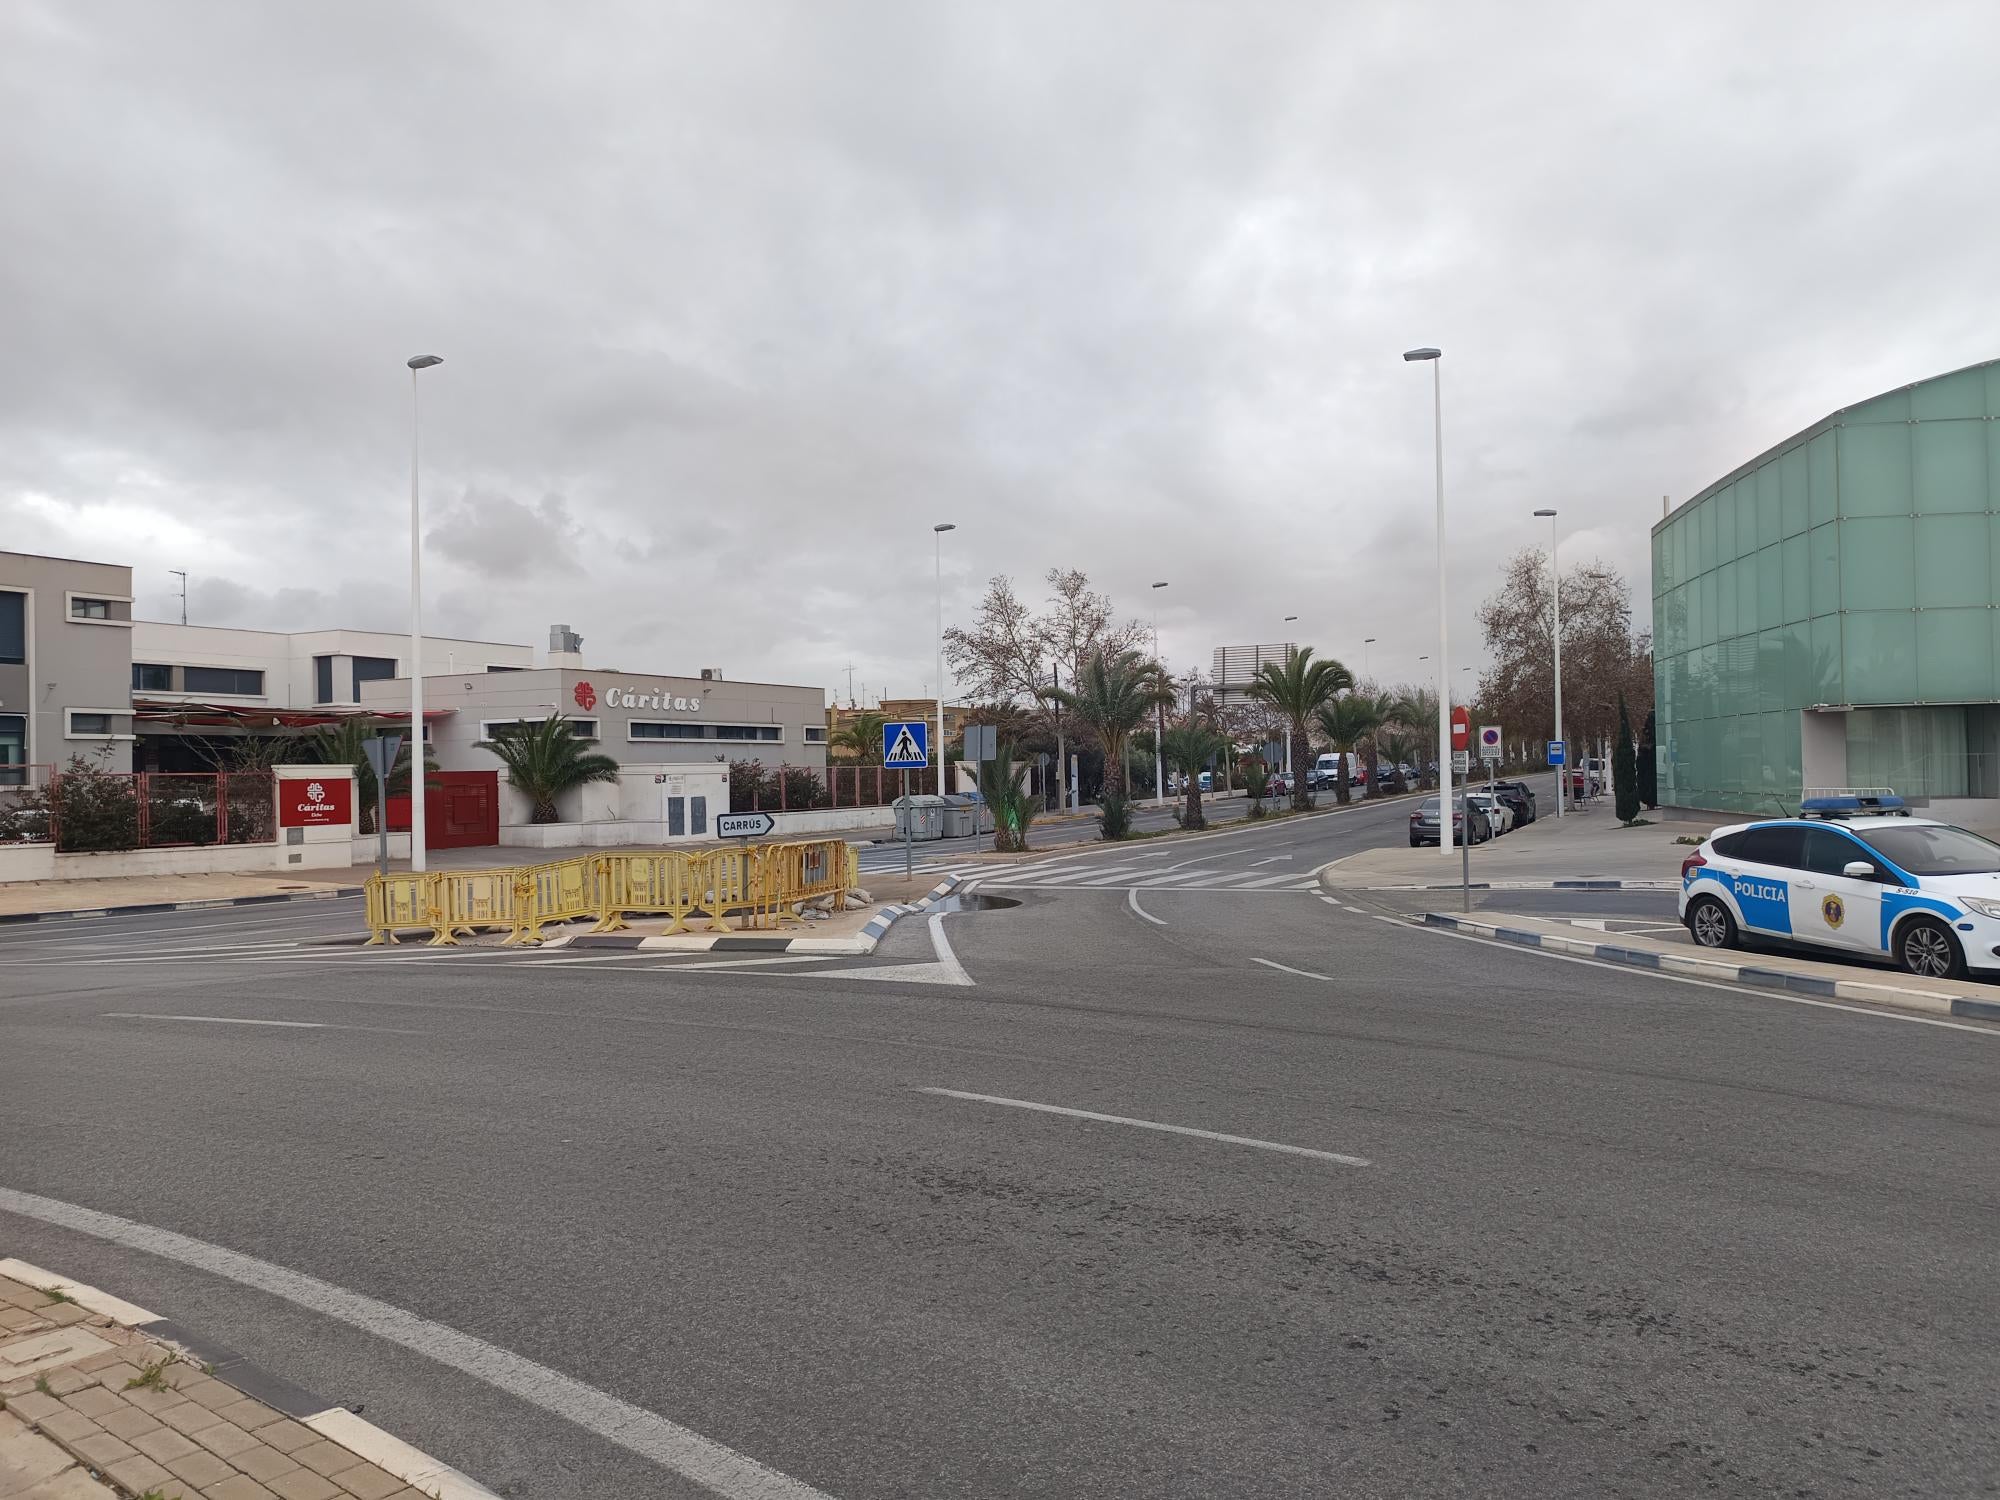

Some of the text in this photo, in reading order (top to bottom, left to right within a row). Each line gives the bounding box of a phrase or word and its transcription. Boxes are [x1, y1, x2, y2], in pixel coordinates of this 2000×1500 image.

[605, 686, 700, 712] Cáritas
[297, 803, 335, 812] Cáritas
[723, 818, 761, 831] CARRÚS
[1734, 881, 1786, 903] POLICIA
